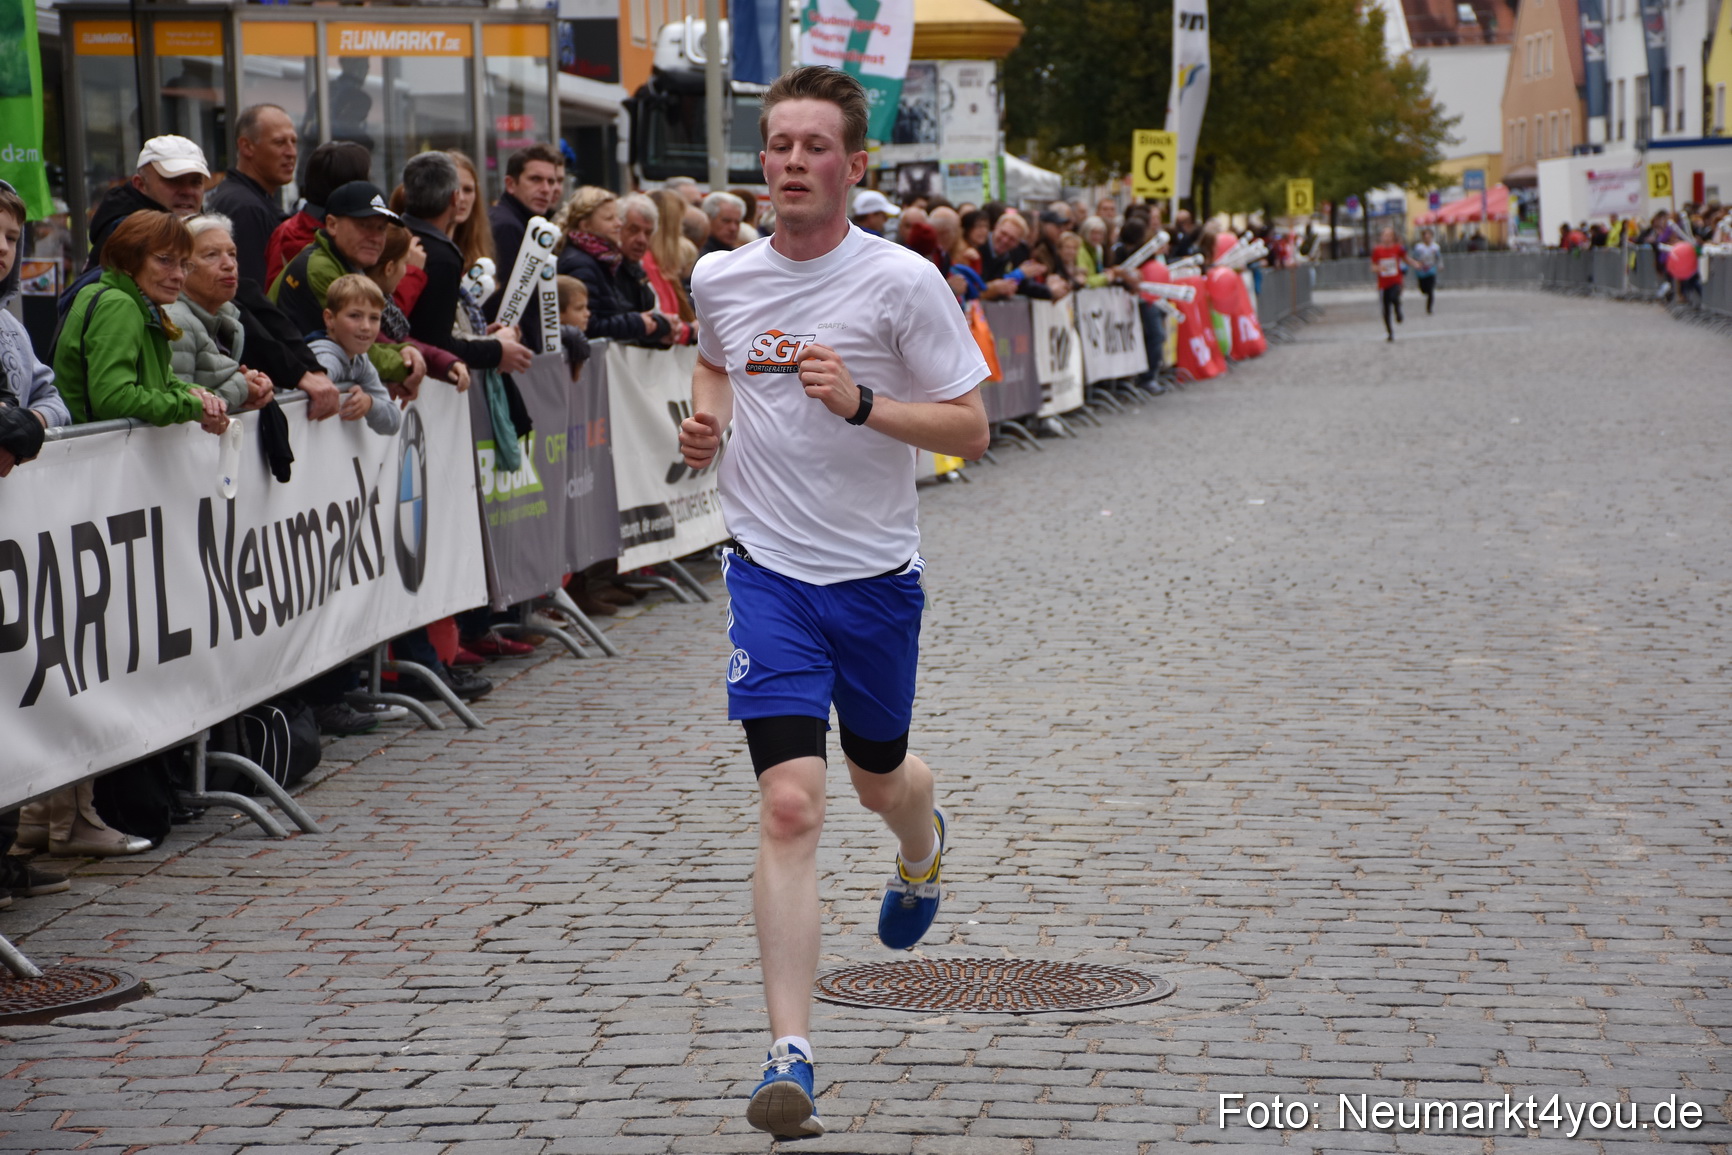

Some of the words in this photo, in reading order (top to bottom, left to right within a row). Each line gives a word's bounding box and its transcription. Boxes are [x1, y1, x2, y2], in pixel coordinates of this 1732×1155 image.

[1144, 150, 1165, 182] C
[1655, 172, 1669, 191] D
[542, 291, 558, 330] BMW
[748, 333, 816, 363] SGT
[0, 506, 192, 708] PARTL
[198, 456, 385, 649] Neumarkt
